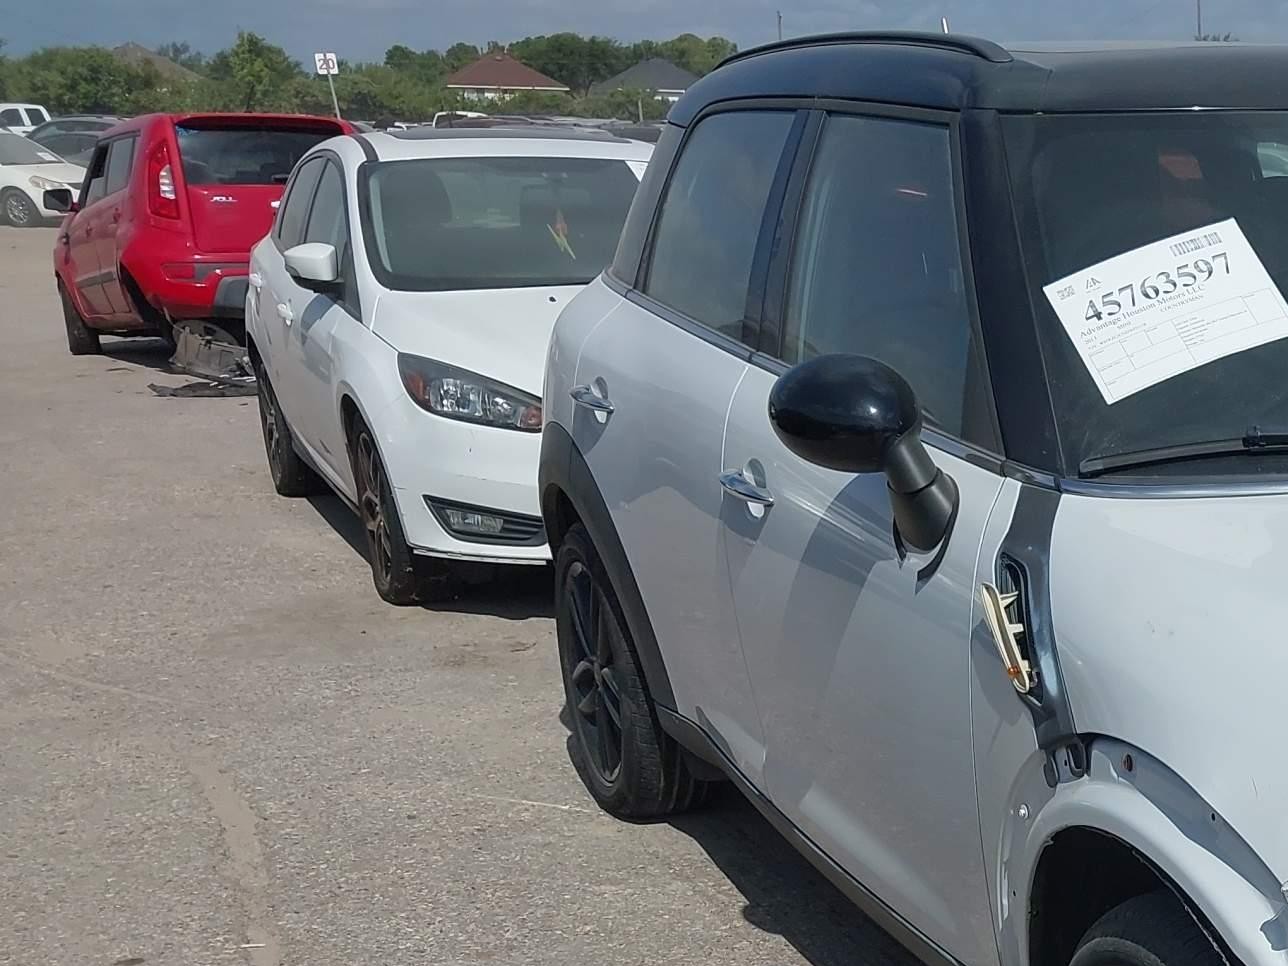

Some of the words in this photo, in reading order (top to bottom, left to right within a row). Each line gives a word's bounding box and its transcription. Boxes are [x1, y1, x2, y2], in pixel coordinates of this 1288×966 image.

[318, 58, 335, 70] 20
[1080, 317, 1121, 338] Advantage
[1122, 303, 1157, 321] Houston
[1156, 293, 1186, 306] Motors
[1186, 284, 1204, 295] LLC
[1085, 252, 1230, 321] 45763597
